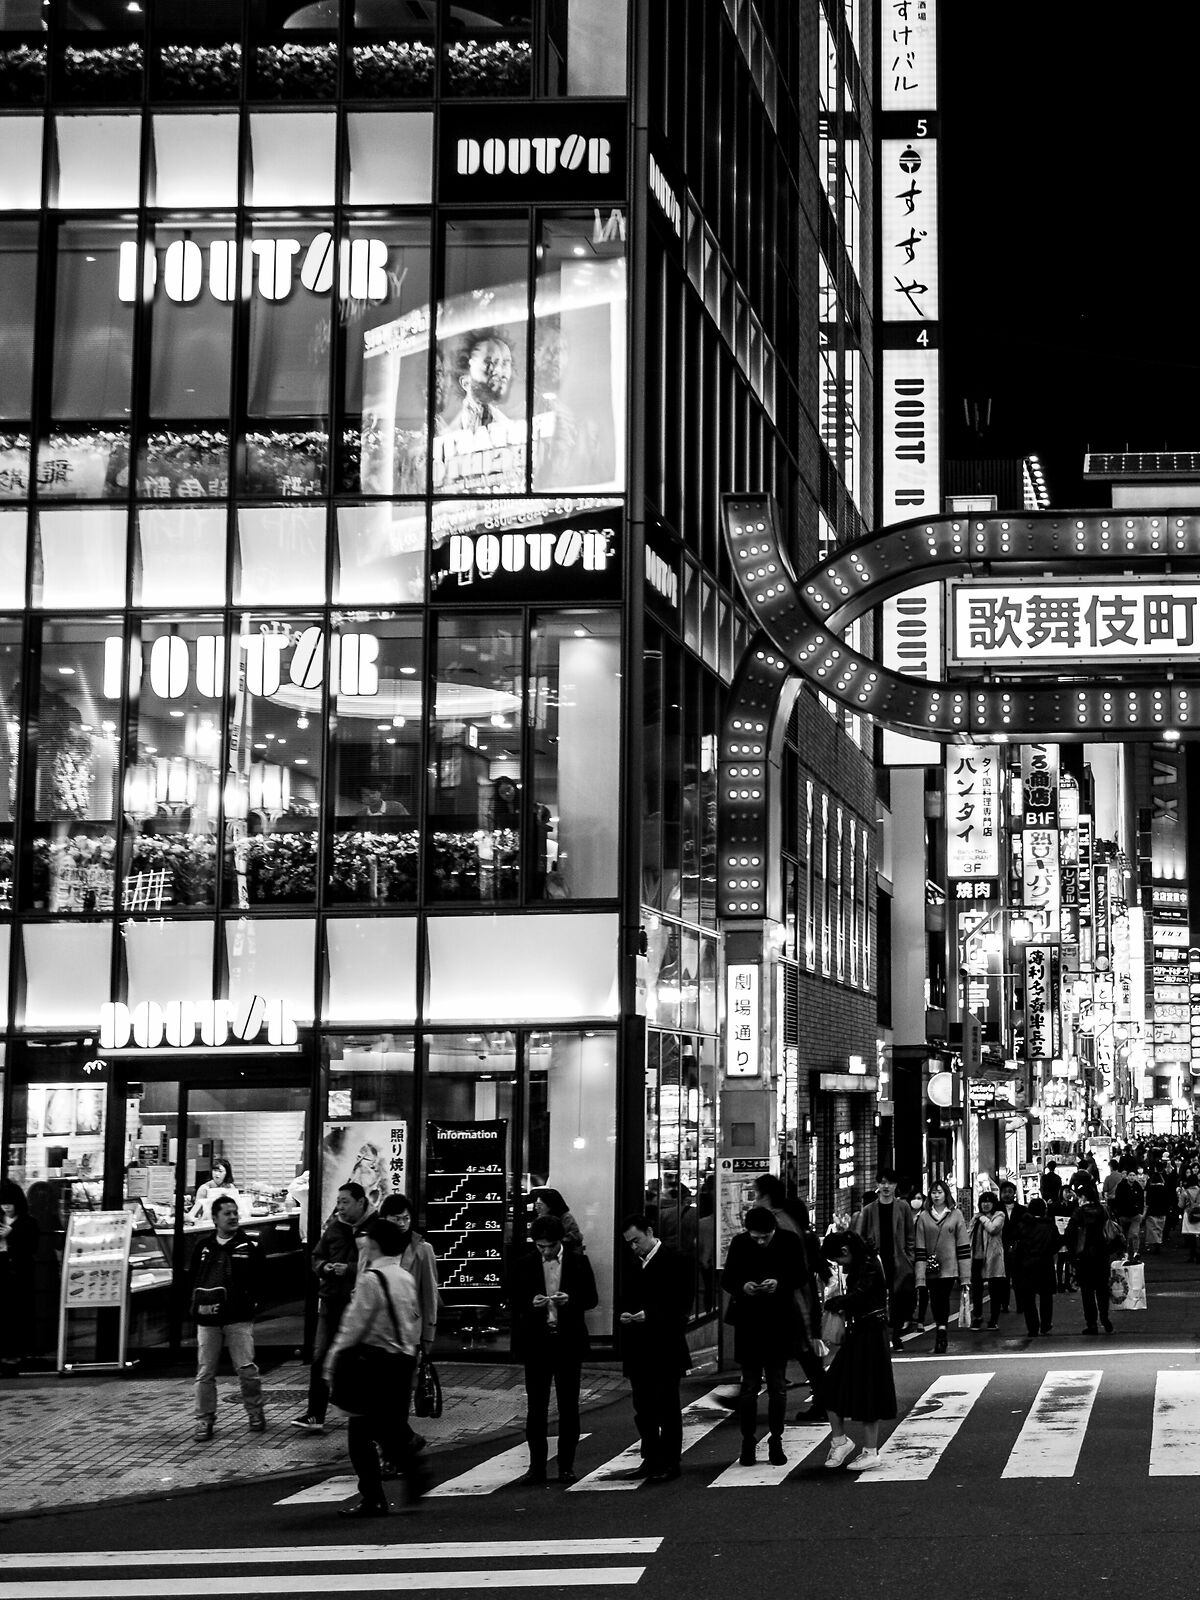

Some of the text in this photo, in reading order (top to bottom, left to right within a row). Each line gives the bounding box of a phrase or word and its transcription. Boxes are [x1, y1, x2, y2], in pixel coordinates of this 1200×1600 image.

[916, 120, 927, 136] 5
[457, 133, 611, 175] DOUTOR
[895, 179, 928, 317] すずや
[916, 330, 929, 346] 4
[449, 529, 608, 572] DOUTOR
[954, 757, 978, 843] バンタイ
[1026, 812, 1055, 825] B1F
[964, 863, 981, 872] 3F
[956, 882, 991, 899] 焼肉
[436, 1130, 498, 1140] information
